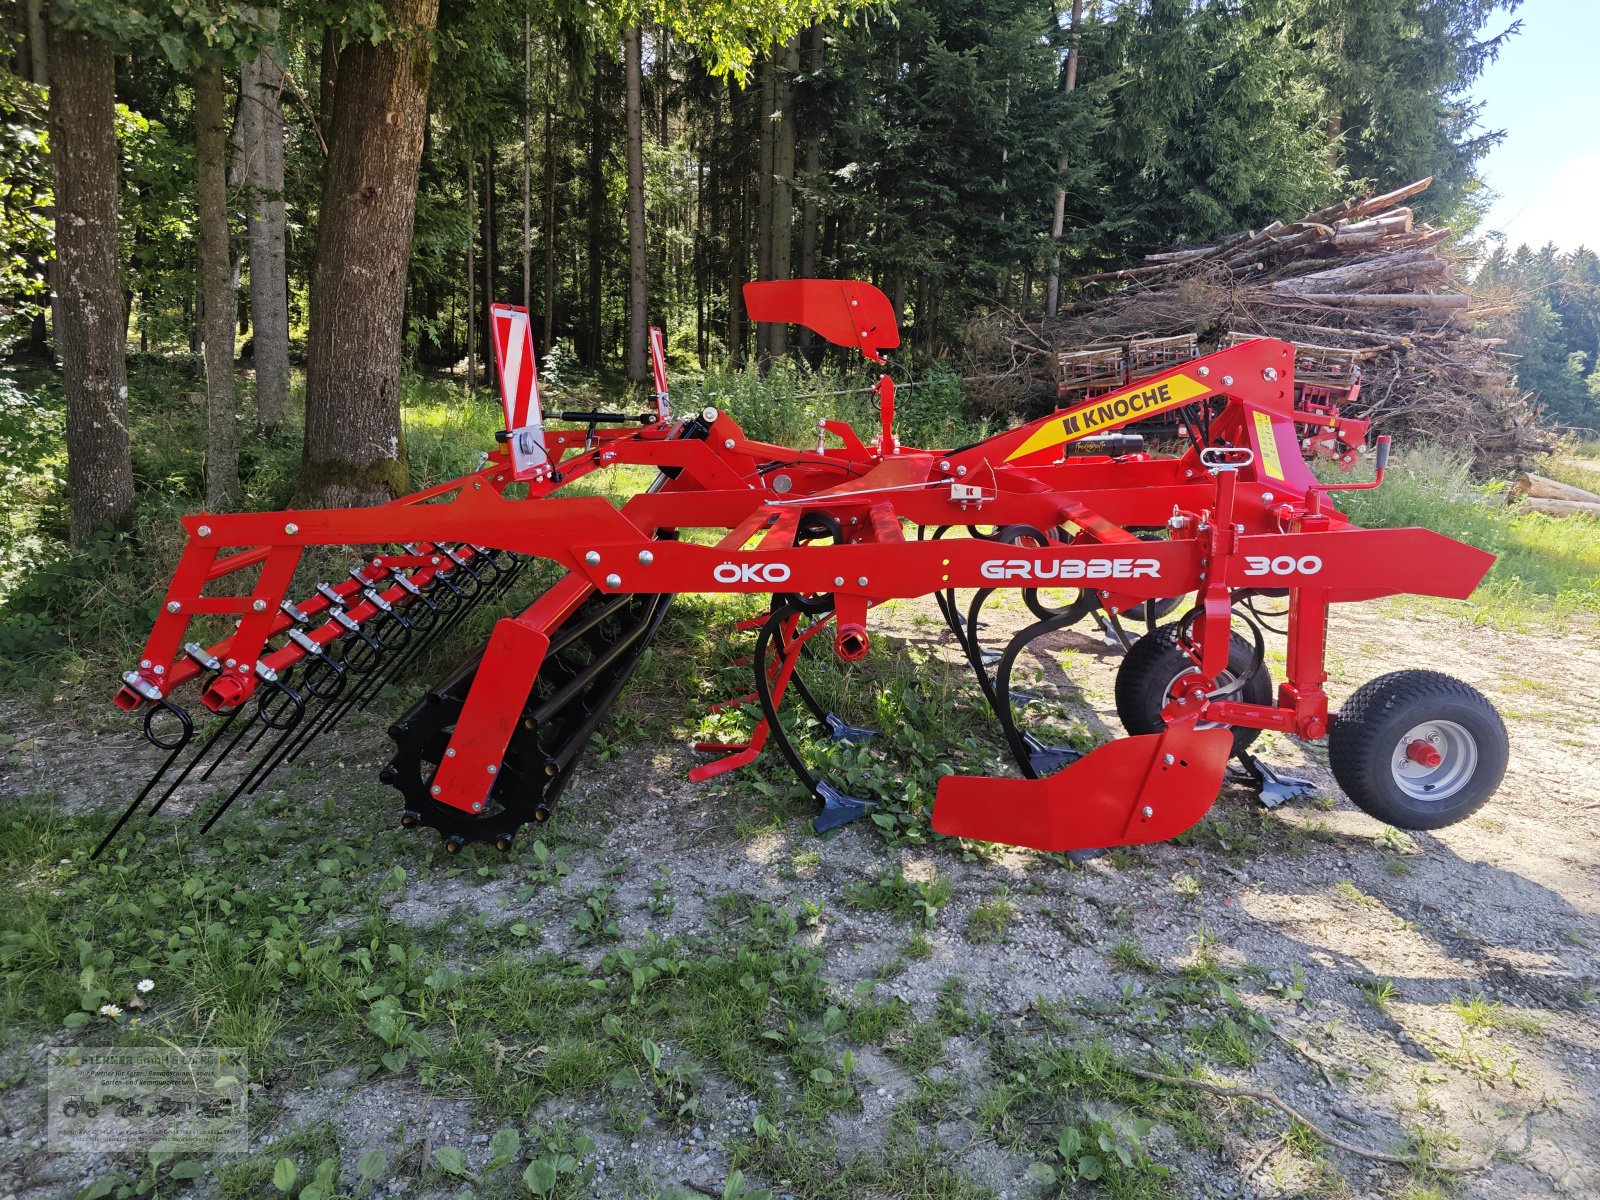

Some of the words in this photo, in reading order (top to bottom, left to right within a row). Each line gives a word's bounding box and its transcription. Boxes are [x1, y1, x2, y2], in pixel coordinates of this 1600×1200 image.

[1083, 384, 1172, 428] KNOCHE
[713, 561, 792, 584] ÖKO
[981, 557, 1162, 580] GRUBBER
[1244, 555, 1323, 576] 300
